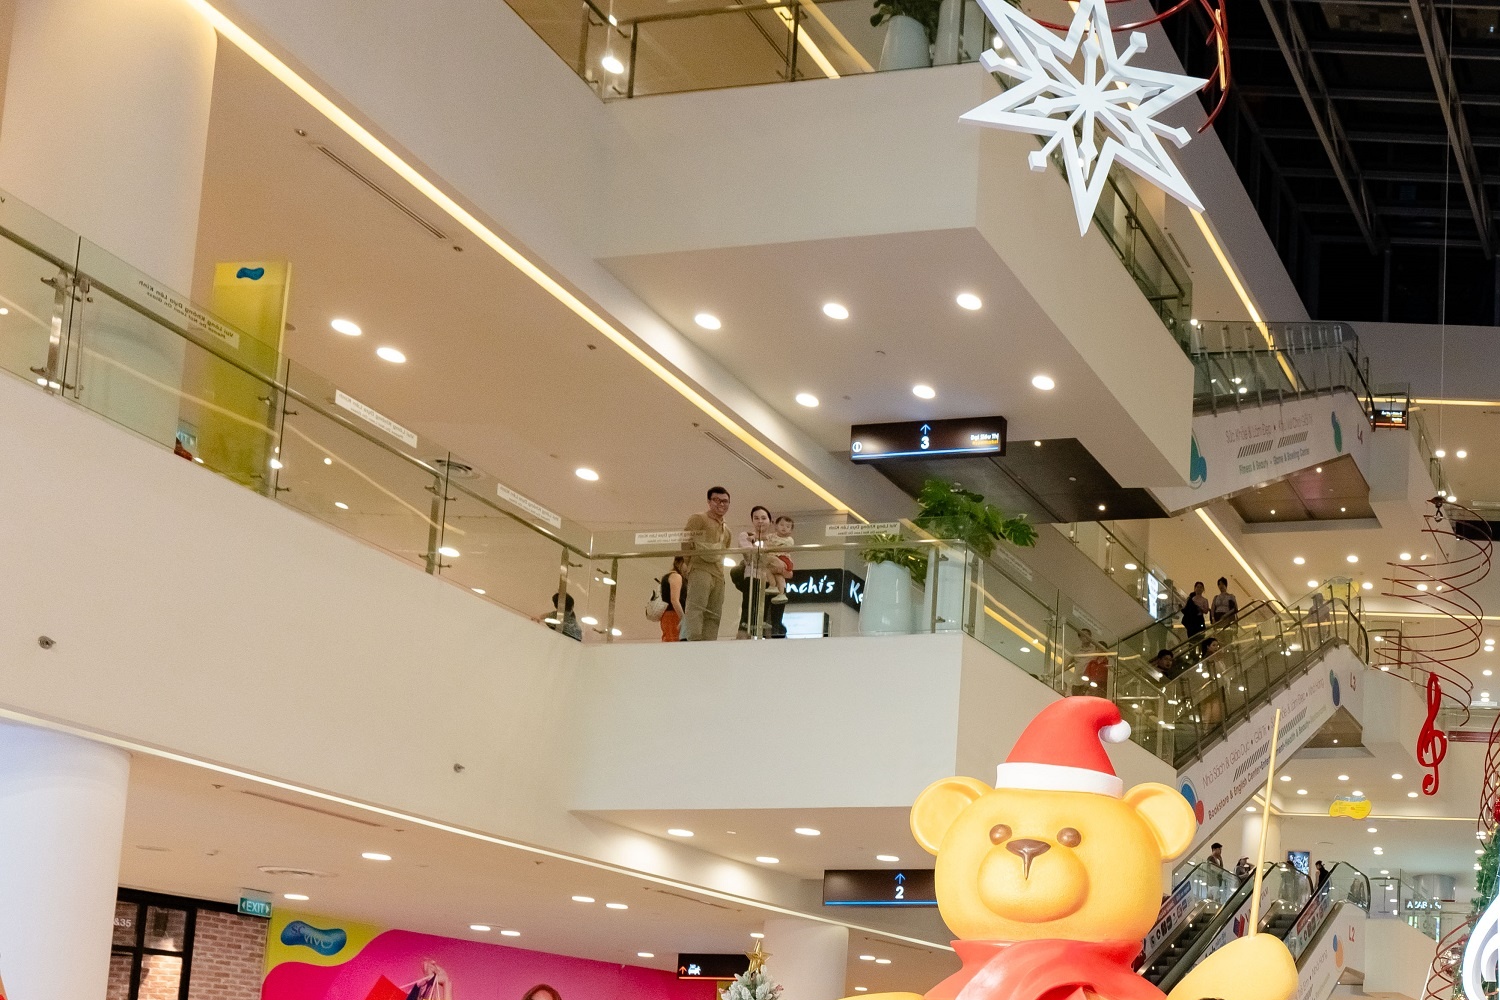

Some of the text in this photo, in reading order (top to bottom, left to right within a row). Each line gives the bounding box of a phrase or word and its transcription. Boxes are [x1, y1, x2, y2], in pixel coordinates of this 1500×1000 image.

[920, 435, 930, 450] 3
[1208, 797, 1230, 820] Bookstore
[895, 885, 904, 899] 2
[245, 902, 265, 914] EXIT
